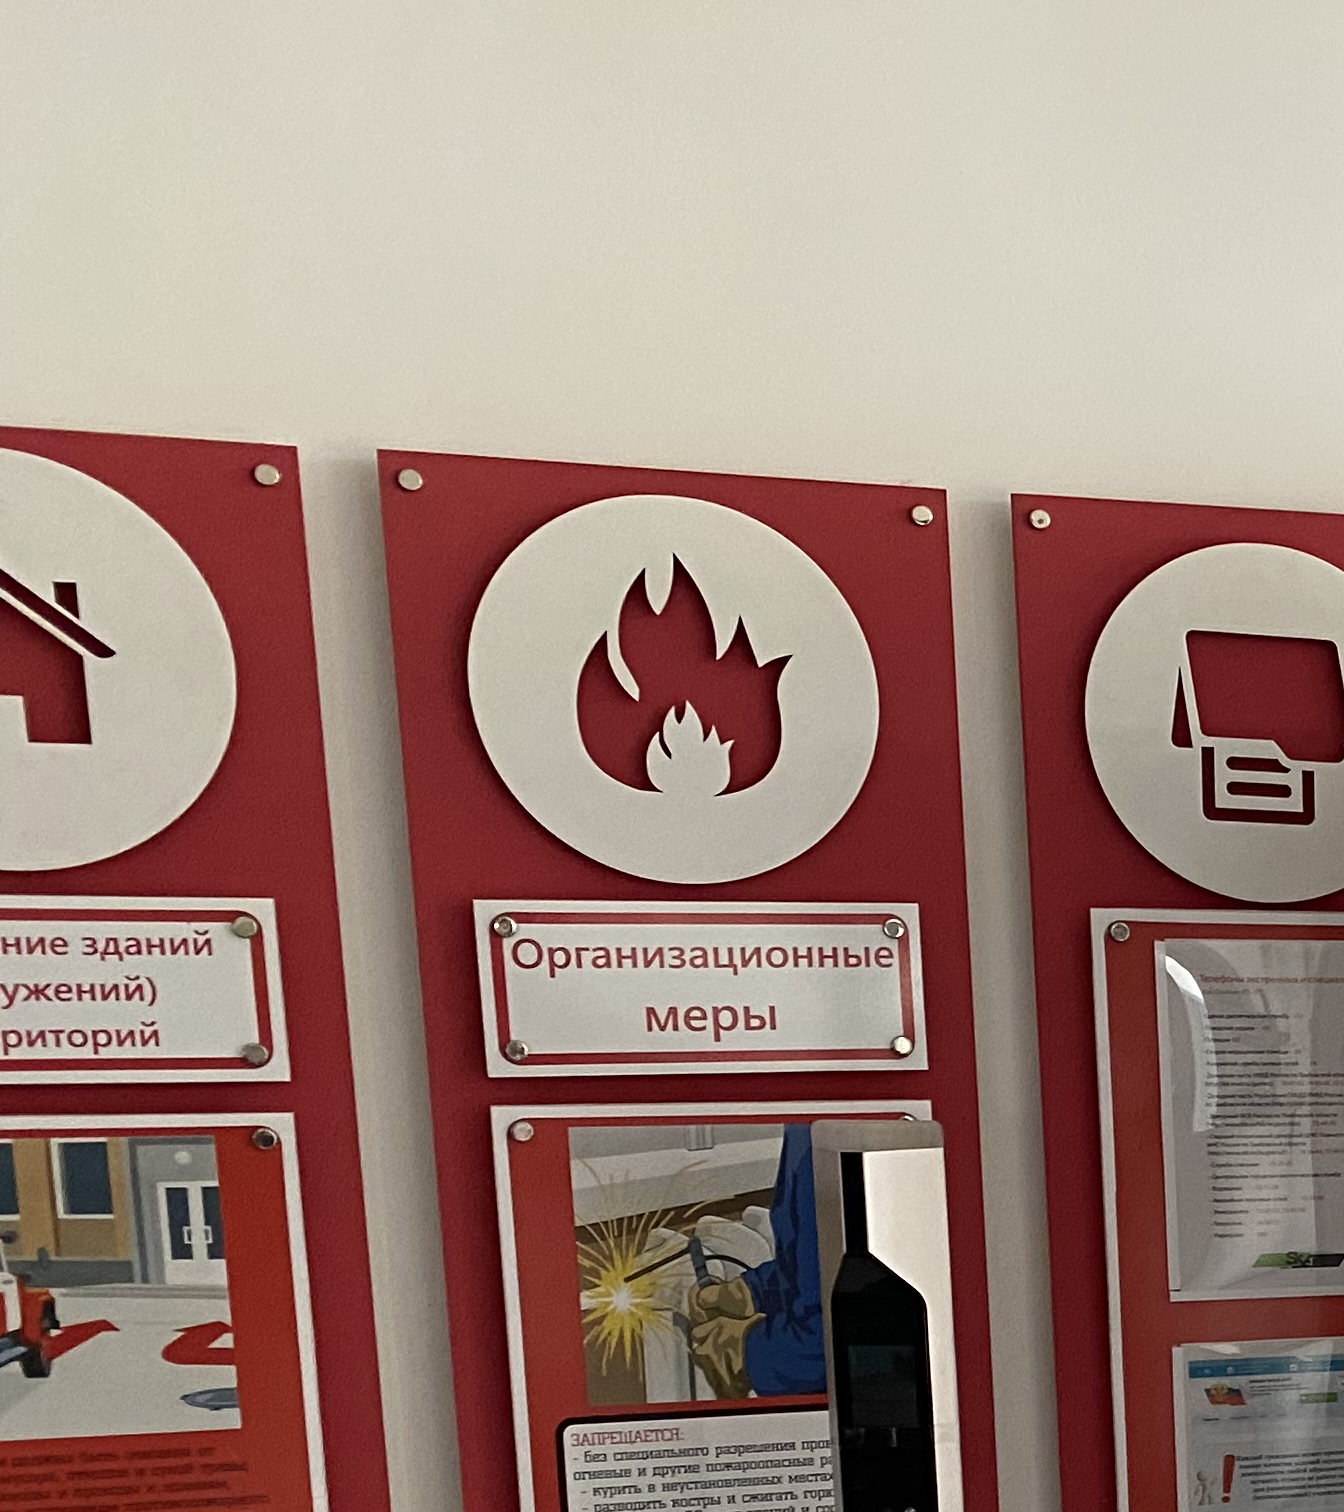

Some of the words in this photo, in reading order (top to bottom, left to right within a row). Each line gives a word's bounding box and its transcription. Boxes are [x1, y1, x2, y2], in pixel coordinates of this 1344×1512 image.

[82, 929, 213, 961] зданий
[511, 938, 895, 977] Организационные
[0, 976, 157, 1008] ужений)
[645, 1003, 778, 1042] меры
[1, 1022, 160, 1056] риторий
[571, 1427, 685, 1447] ЗАПРЕЩАЕТСЯ:
[584, 1450, 607, 1463] без
[613, 1447, 709, 1461] специального
[715, 1441, 796, 1458] разрешения
[573, 1468, 632, 1481] огневые
[637, 1467, 648, 1478] и
[652, 1464, 701, 1479] другие
[705, 1457, 815, 1473] пожароопасные
[592, 1485, 642, 1499] курить
[647, 1483, 656, 1493] в
[661, 1475, 784, 1493] неустановленных
[670, 1496, 721, 1509] костры
[726, 1494, 736, 1505] и
[741, 1491, 799, 1504] сжигать
